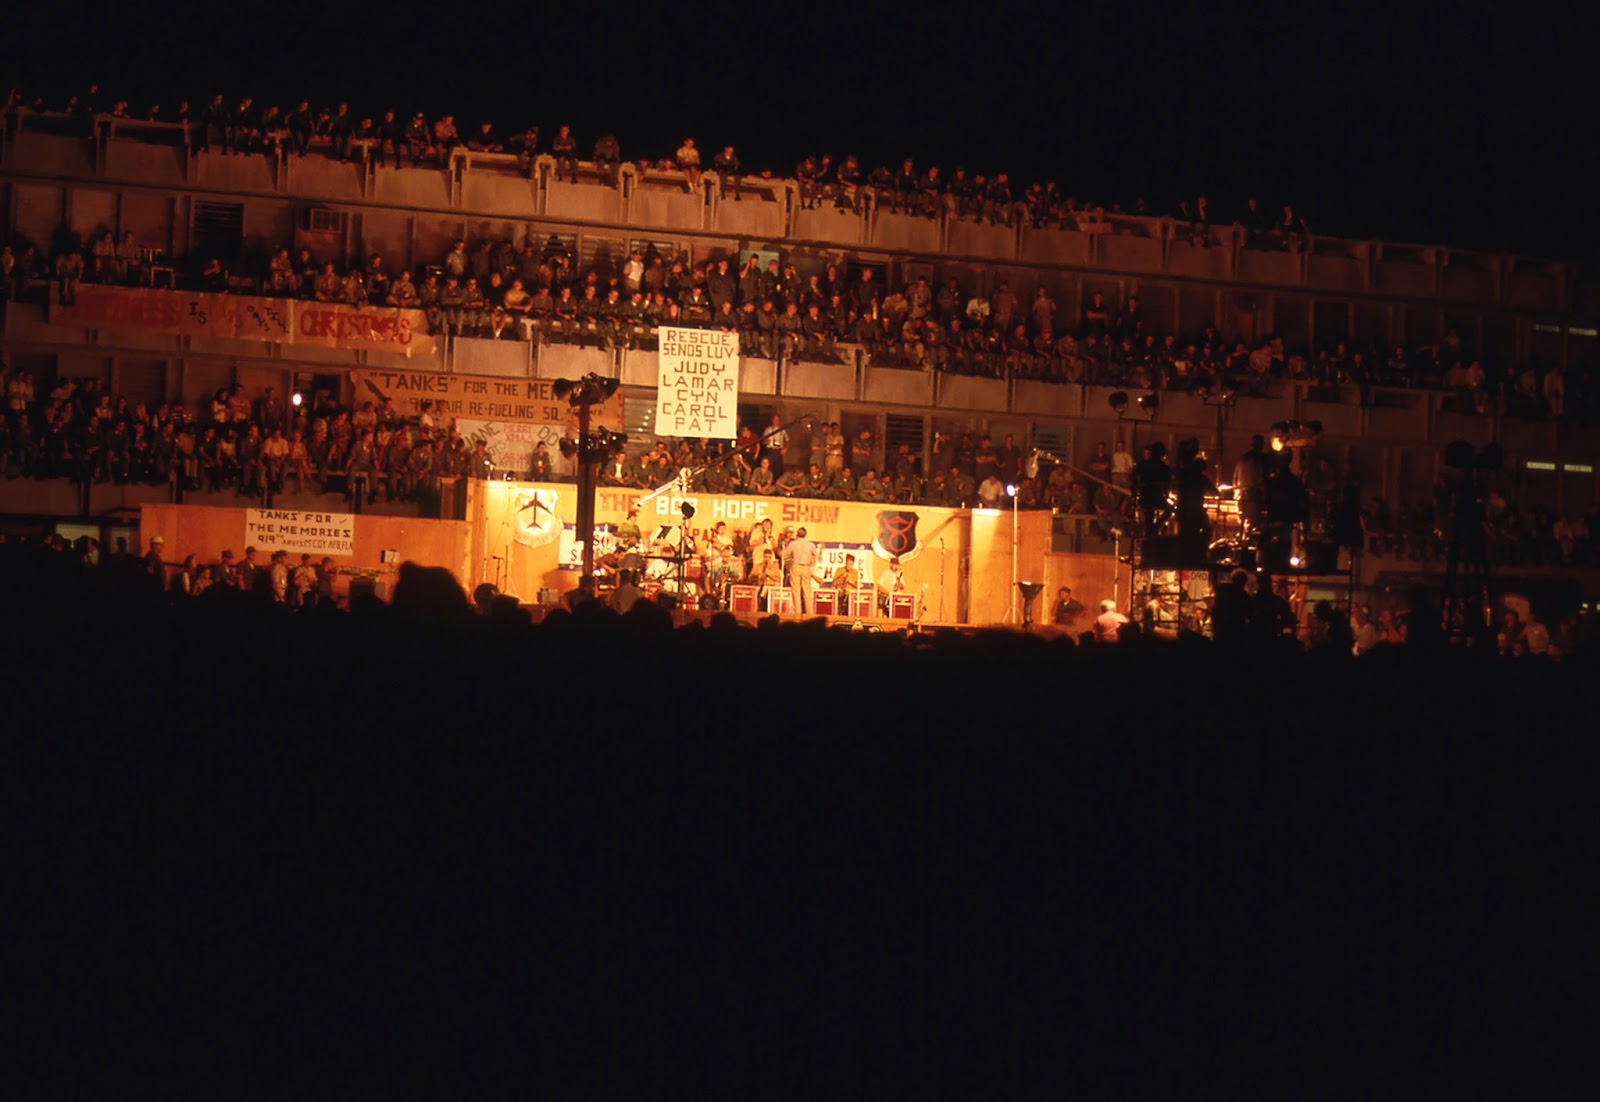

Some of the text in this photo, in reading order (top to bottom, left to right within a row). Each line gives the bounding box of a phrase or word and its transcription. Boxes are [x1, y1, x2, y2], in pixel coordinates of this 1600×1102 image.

[667, 330, 731, 346] RESCUE
[707, 345, 734, 359] LUV
[674, 360, 726, 376] JUDY
[464, 380, 488, 395] FOR
[494, 383, 519, 397] THE
[663, 374, 734, 392] LAMAR
[676, 389, 718, 404] CYN
[469, 401, 534, 419] RE-FUELING
[662, 402, 728, 418] CAROL
[675, 416, 717, 433] PAT
[599, 493, 641, 512] THE
[713, 498, 768, 520] HOPE
[782, 503, 840, 524] SHOW
[305, 513, 331, 524] FOR
[248, 522, 352, 538] THE MEMORIES
